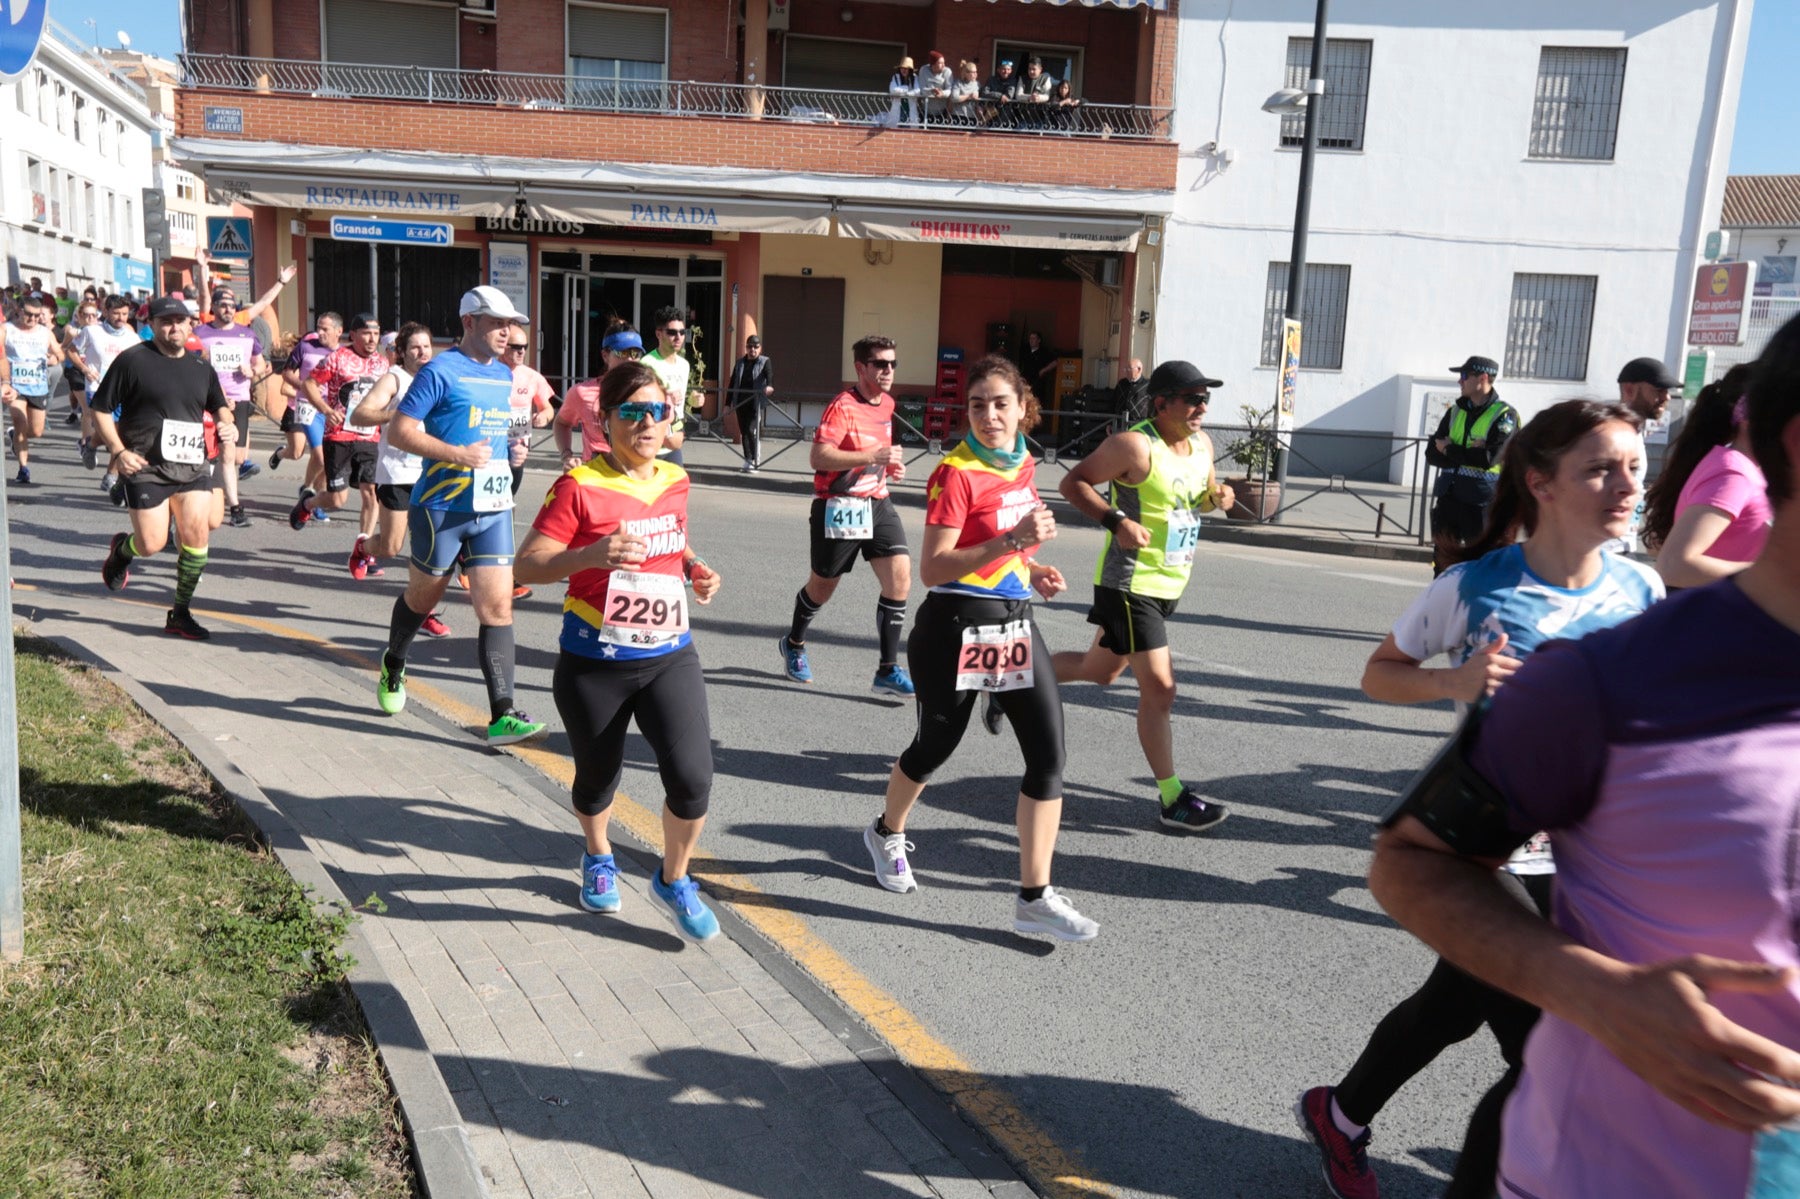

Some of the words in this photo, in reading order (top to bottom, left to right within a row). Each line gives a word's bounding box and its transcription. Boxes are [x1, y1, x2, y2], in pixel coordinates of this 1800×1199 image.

[207, 122, 241, 132] CAMARERO
[216, 115, 239, 124] JACOBO
[305, 185, 460, 211] RESTAURANTE
[631, 203, 718, 225] PARADA
[334, 223, 382, 236] Granada
[407, 227, 431, 239] A-44
[486, 216, 585, 235] BICHITOS
[1694, 300, 1710, 310] Gran
[1711, 299, 1741, 312] apertura
[1691, 332, 1735, 343] ALBOLOTE
[215, 353, 241, 362] 3045
[168, 434, 205, 449] 3142
[483, 476, 509, 495] 437
[626, 514, 677, 536] RUNNER
[833, 510, 863, 525] 411
[641, 531, 686, 558] OMAN
[609, 595, 682, 626] 2291
[963, 642, 1027, 669] 2030
